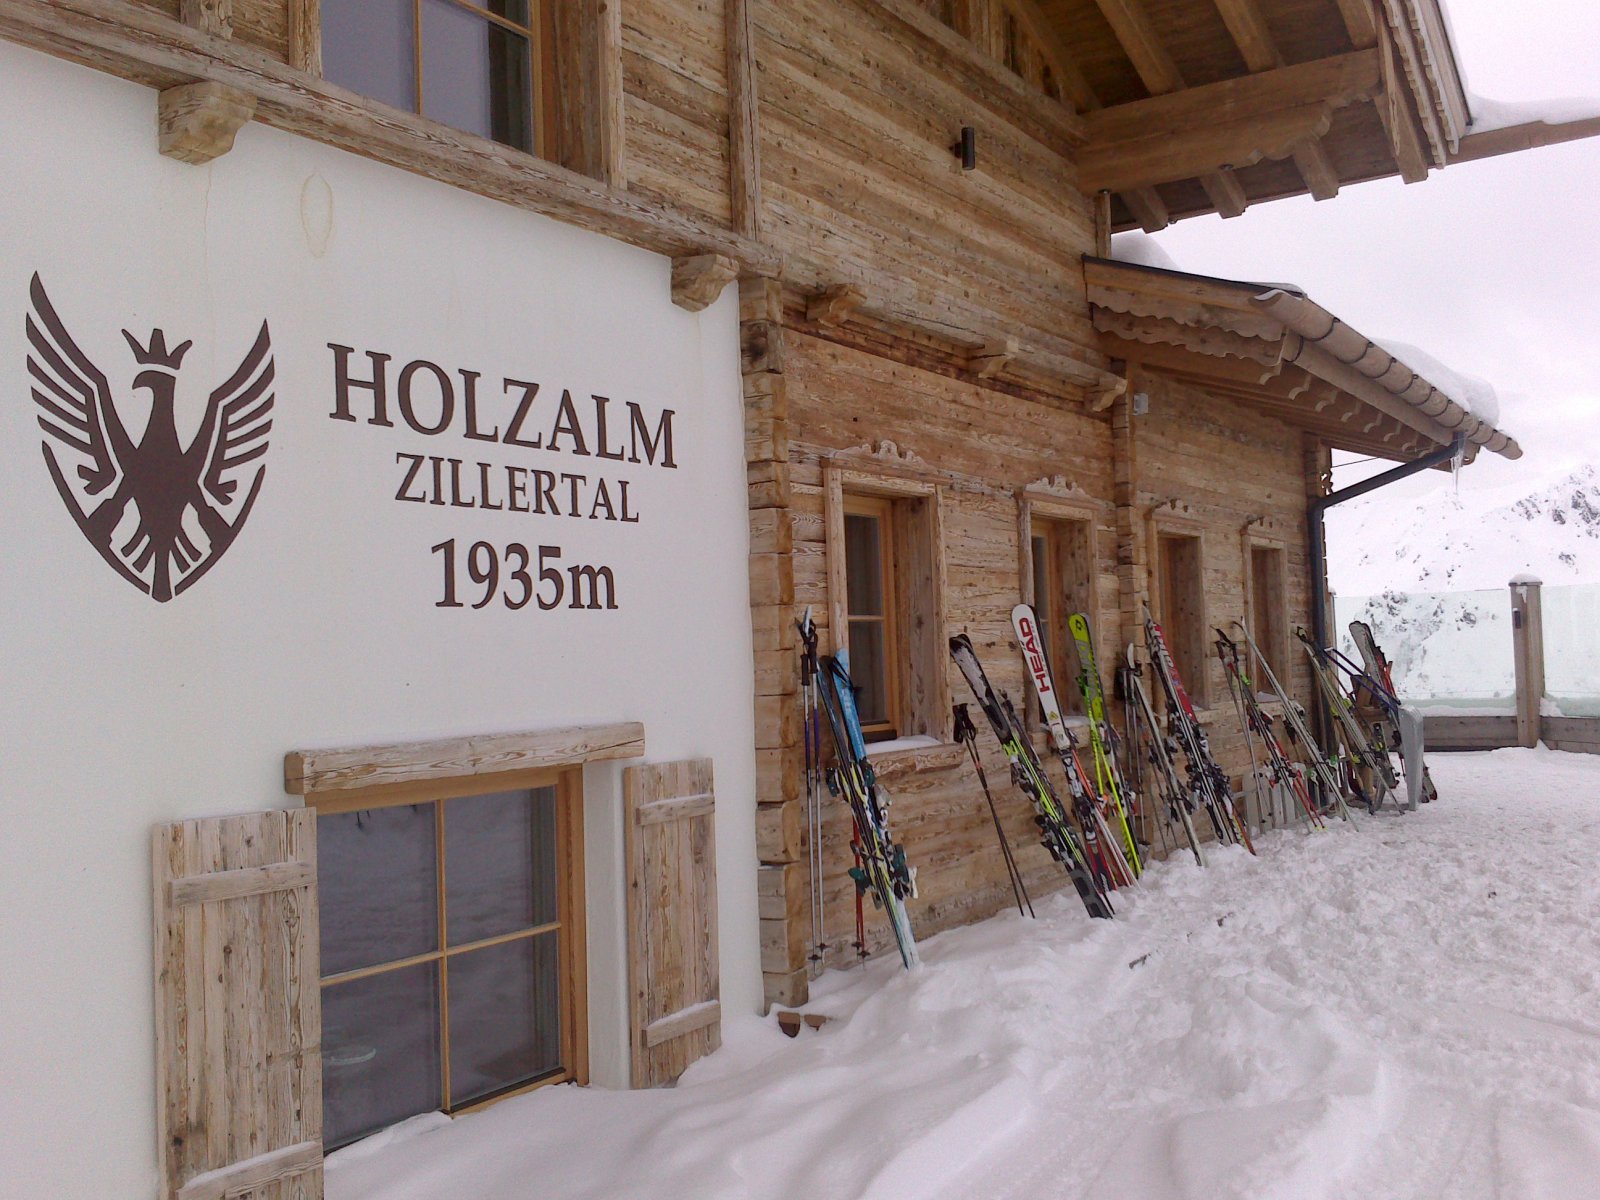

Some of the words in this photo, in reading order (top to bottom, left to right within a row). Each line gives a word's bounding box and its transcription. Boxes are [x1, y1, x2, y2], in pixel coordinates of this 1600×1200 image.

[327, 342, 678, 469] HOLZALM
[395, 452, 640, 523] ZILLERTAL
[431, 538, 619, 611] 1935m
[1018, 617, 1051, 693] HEAD
